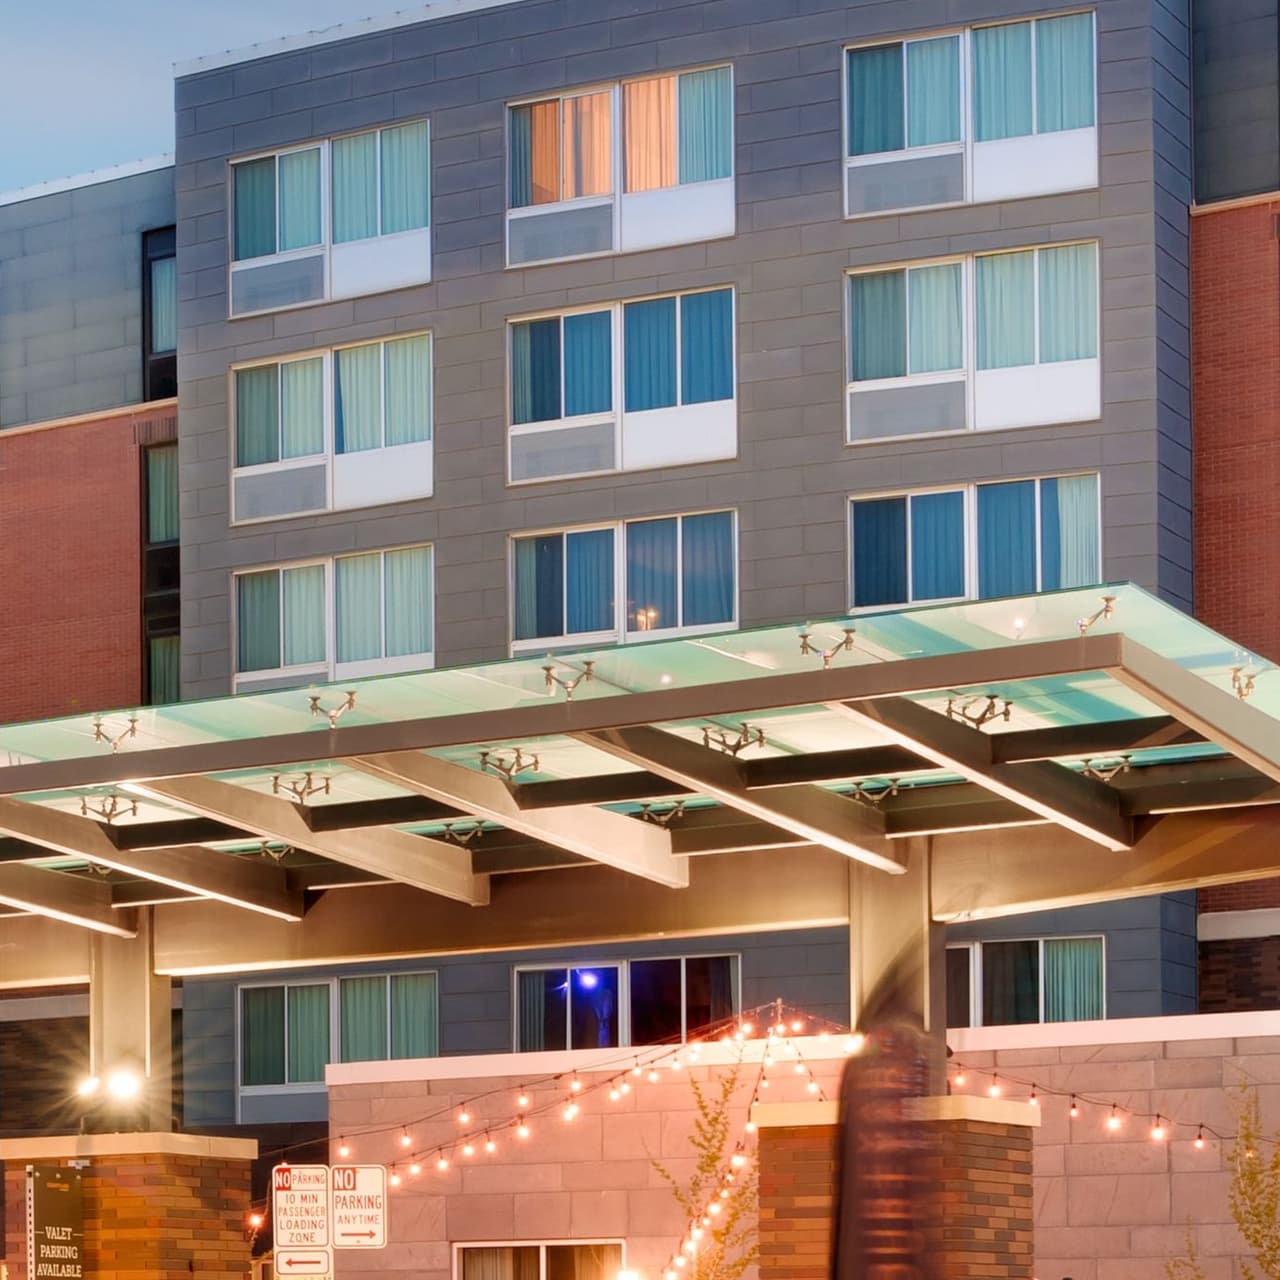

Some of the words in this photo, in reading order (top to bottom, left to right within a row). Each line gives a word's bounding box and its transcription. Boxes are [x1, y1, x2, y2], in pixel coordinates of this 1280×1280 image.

[275, 1171, 290, 1187] NO
[292, 1173, 325, 1185] PARKING
[333, 1167, 354, 1189] NO
[285, 1193, 296, 1204] 10
[300, 1193, 318, 1204] MIN
[335, 1195, 382, 1209] PARKING
[278, 1207, 325, 1217] PASSENGER
[280, 1220, 325, 1231] LOADING
[338, 1215, 381, 1225] ANYTIME
[45, 1226, 72, 1240] VALET
[289, 1232, 316, 1243] ZONE
[40, 1244, 78, 1259] PARKING
[37, 1263, 82, 1277] AVAILABLE
